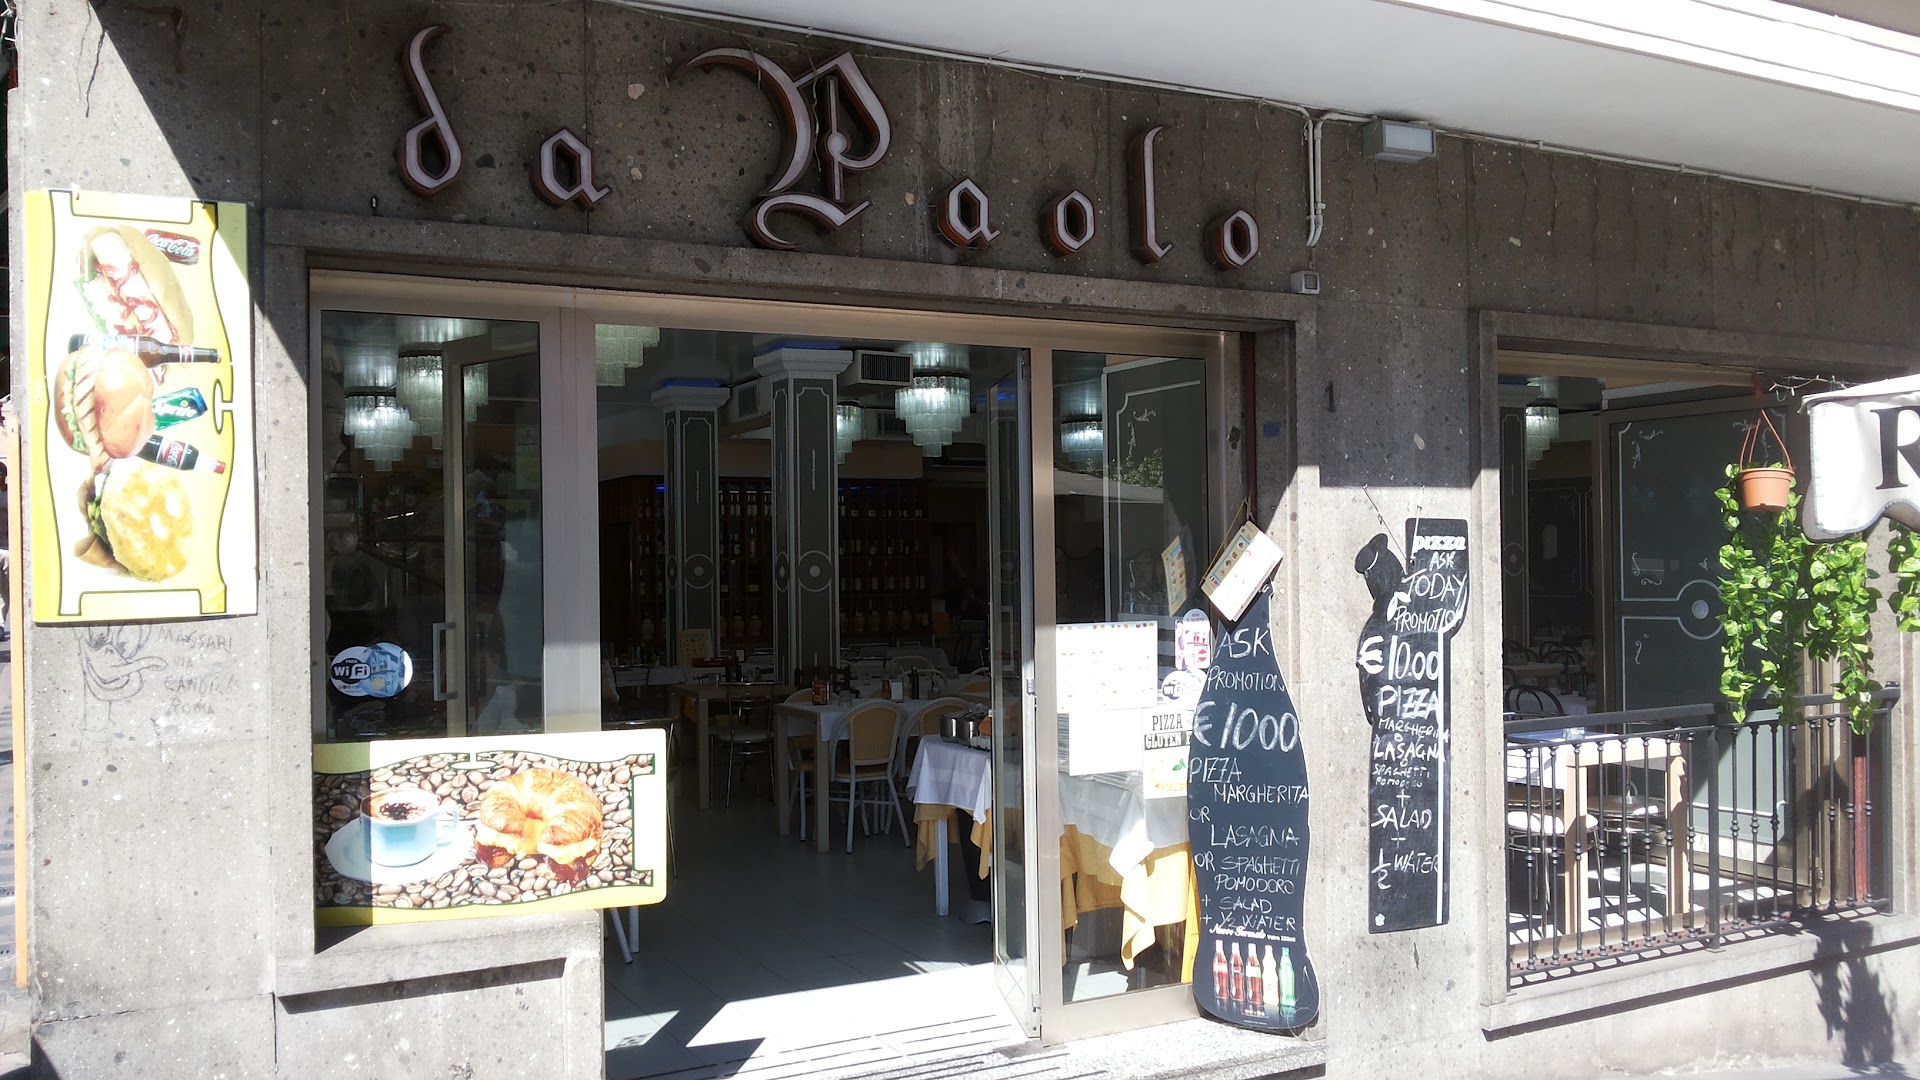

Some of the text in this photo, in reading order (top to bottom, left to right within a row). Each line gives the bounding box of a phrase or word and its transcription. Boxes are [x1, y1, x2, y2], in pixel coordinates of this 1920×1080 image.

[400, 24, 1260, 268] da Paolo
[1412, 535, 1466, 554] pizza
[1428, 551, 1456, 572] ASK
[1401, 568, 1467, 607] TODAY
[1214, 627, 1270, 659] ASK
[1206, 665, 1286, 692] PROMOTION
[1375, 684, 1440, 719] PIZZA
[1151, 713, 1183, 731] PIZZA
[1145, 731, 1182, 749] GLUTEN
[1189, 757, 1242, 784] PIZZA
[1213, 783, 1309, 806] MARGHERITA
[1189, 805, 1211, 823] OR
[1370, 804, 1432, 831] SALAD
[1210, 824, 1300, 849] LASAGNA
[1194, 851, 1300, 877] OR SPAGHETTI
[1394, 850, 1439, 874] WATER
[1213, 873, 1295, 895] POMODORO
[1218, 896, 1273, 914] SALAD
[1241, 915, 1297, 931] WATER
